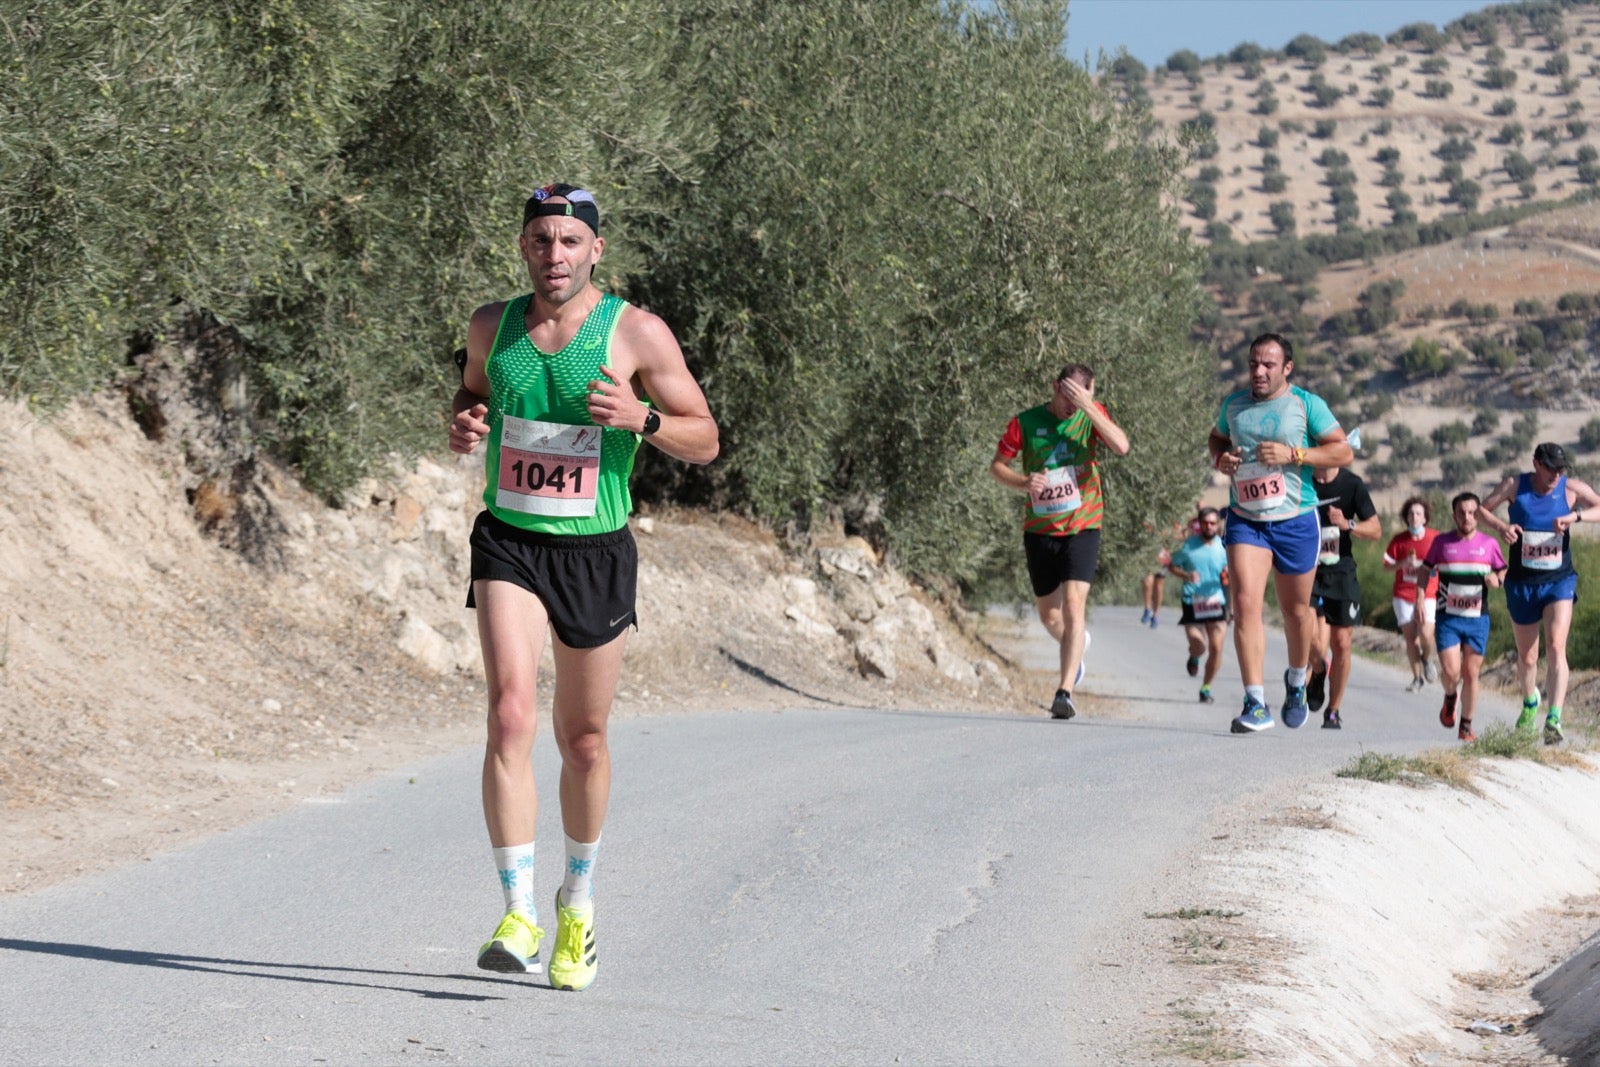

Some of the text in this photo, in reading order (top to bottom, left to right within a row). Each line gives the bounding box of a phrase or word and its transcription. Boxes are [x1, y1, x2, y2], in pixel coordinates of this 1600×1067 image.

[512, 460, 583, 493] 1041
[1242, 480, 1280, 500] 1013
[1528, 545, 1557, 557] 2134
